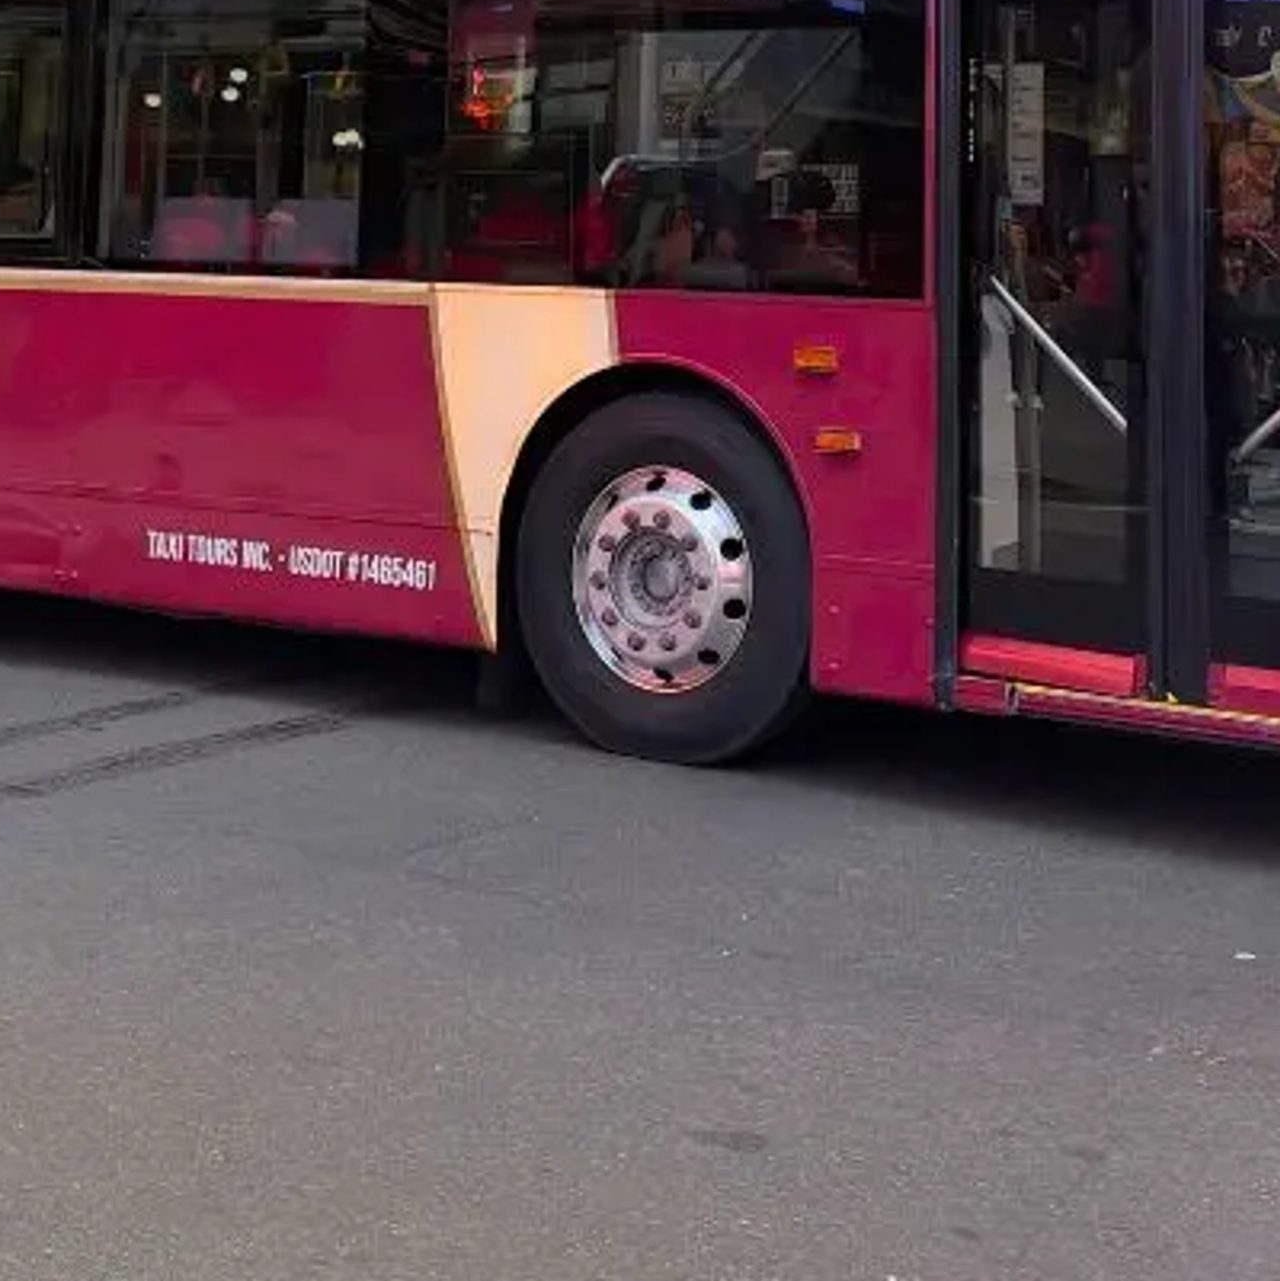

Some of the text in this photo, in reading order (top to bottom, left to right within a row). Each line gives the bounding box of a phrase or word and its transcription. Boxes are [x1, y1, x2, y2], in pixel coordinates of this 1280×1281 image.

[147, 530, 184, 560] TAXI
[188, 534, 238, 567] TOURS
[242, 540, 273, 571] INC.
[288, 545, 344, 581] USDOT
